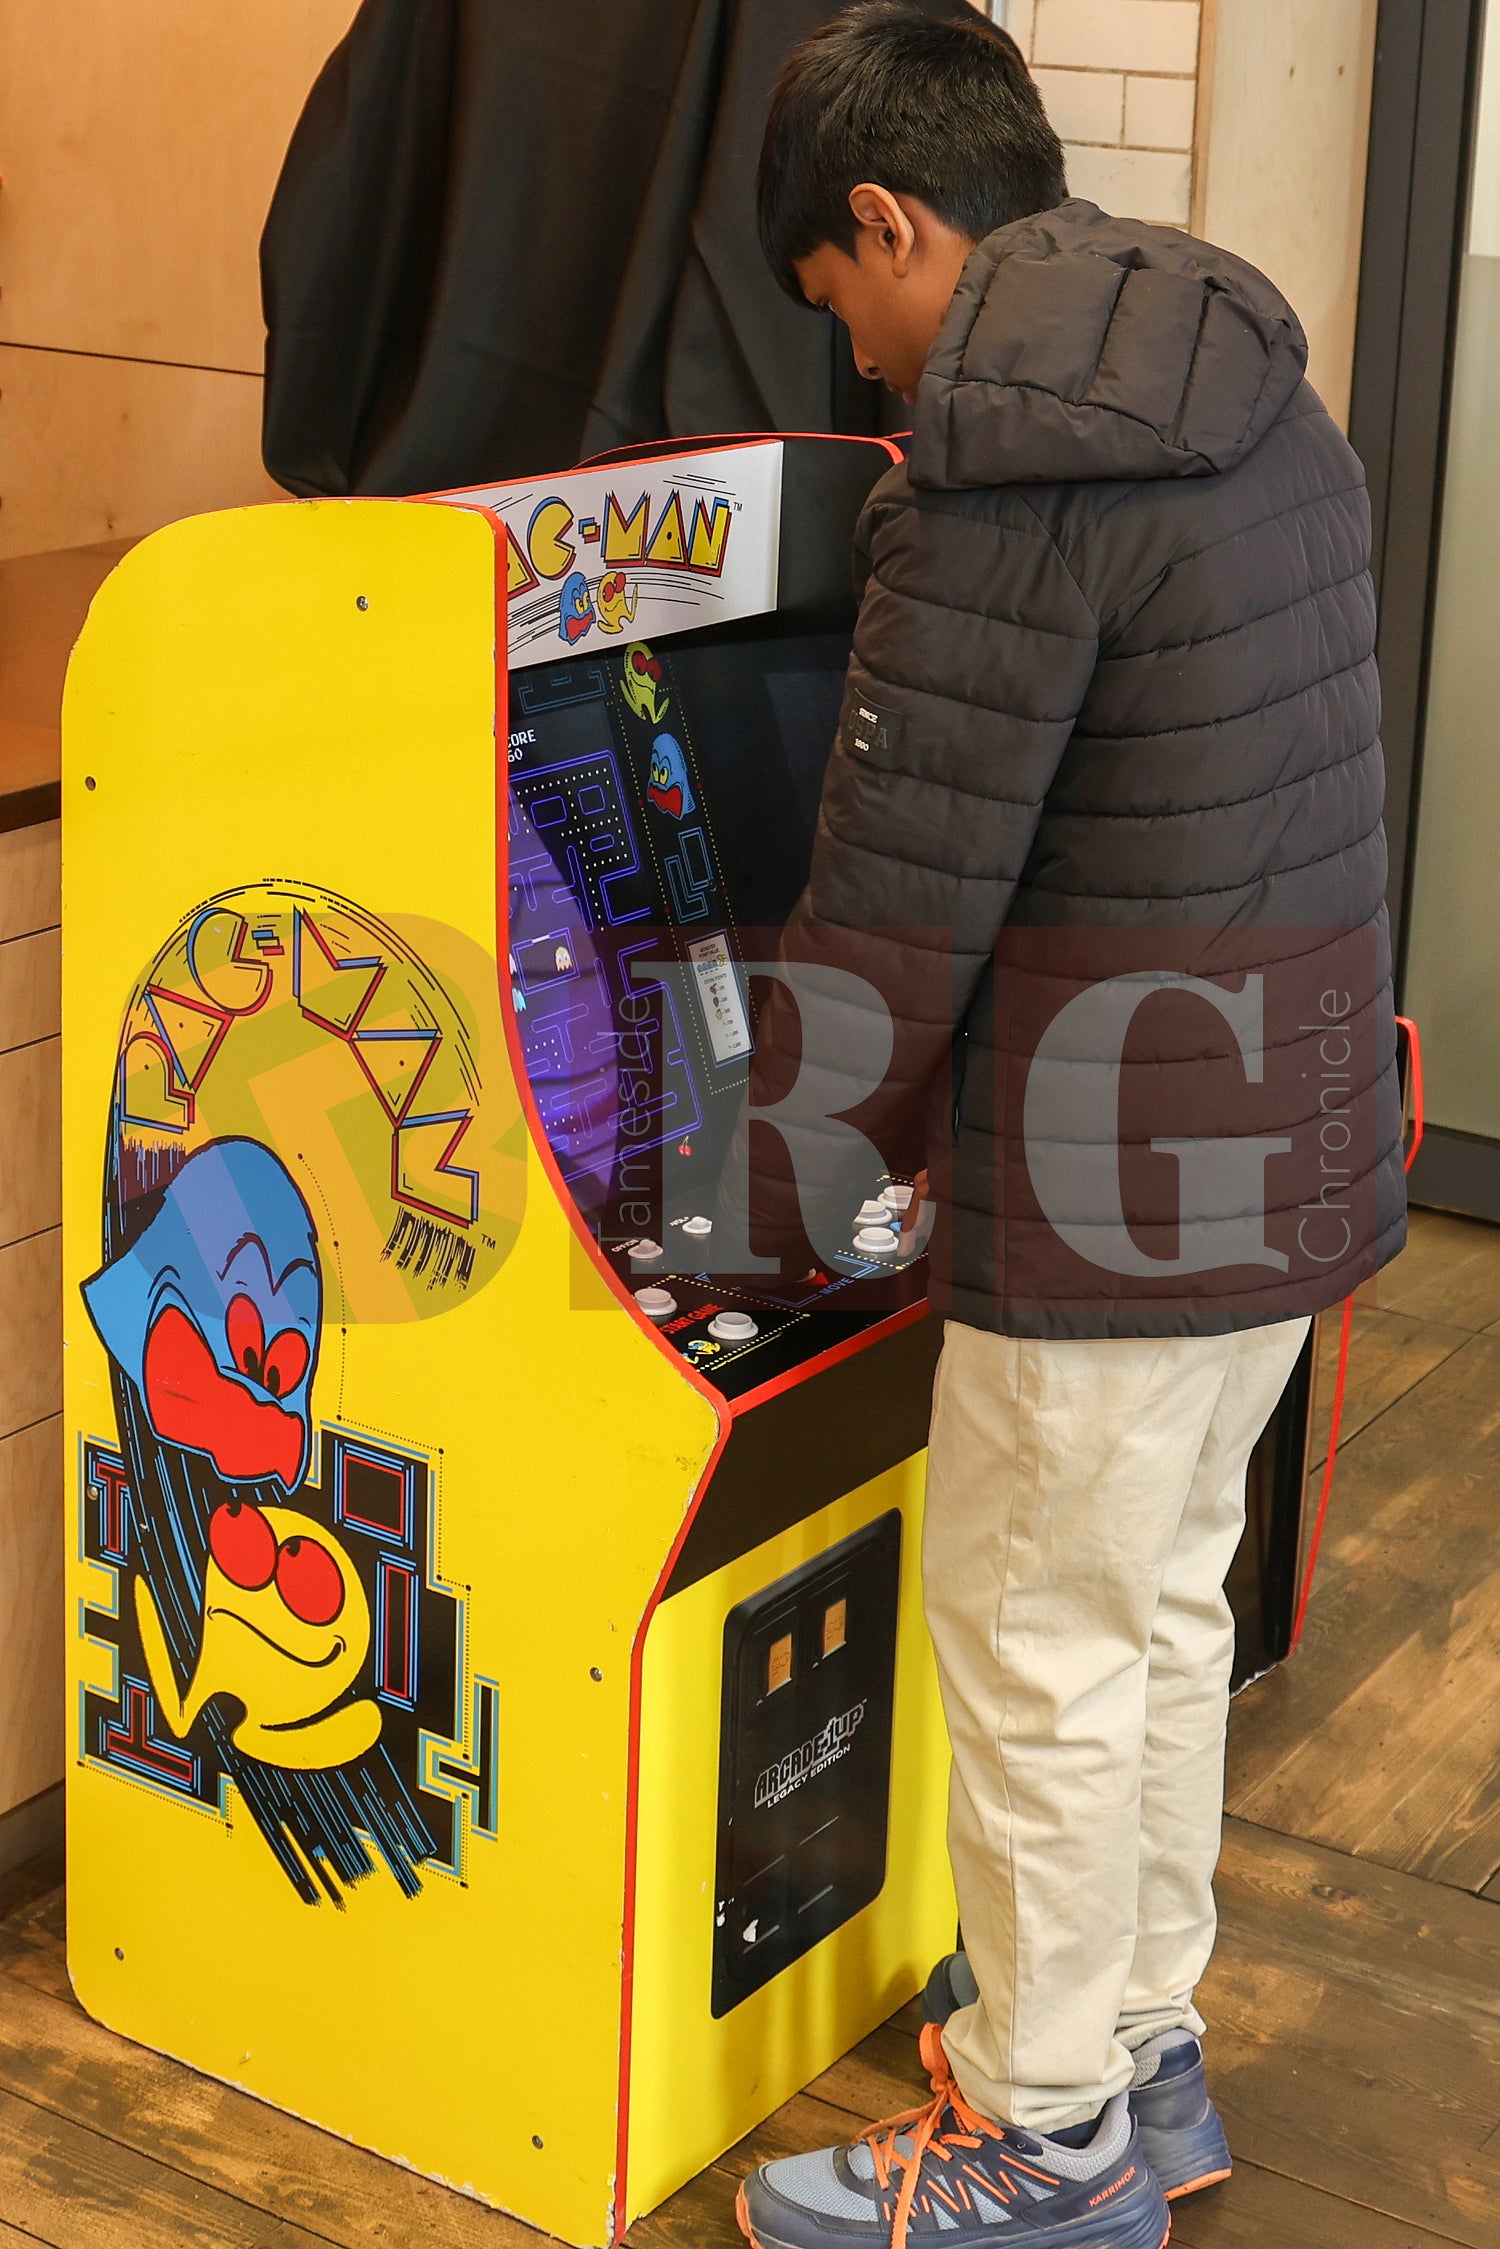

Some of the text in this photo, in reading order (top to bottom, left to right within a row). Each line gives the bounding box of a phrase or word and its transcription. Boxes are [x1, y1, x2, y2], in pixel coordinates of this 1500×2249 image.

[507, 489, 732, 601] AC-MAN
[507, 729, 536, 748] ORE
[118, 904, 496, 1250] PAC-MAN TM
[818, 1276, 855, 1295] MOVE
[766, 1743, 852, 1808] LEGACY EDITION
[1088, 2165, 1137, 2207] KARRIMOR
